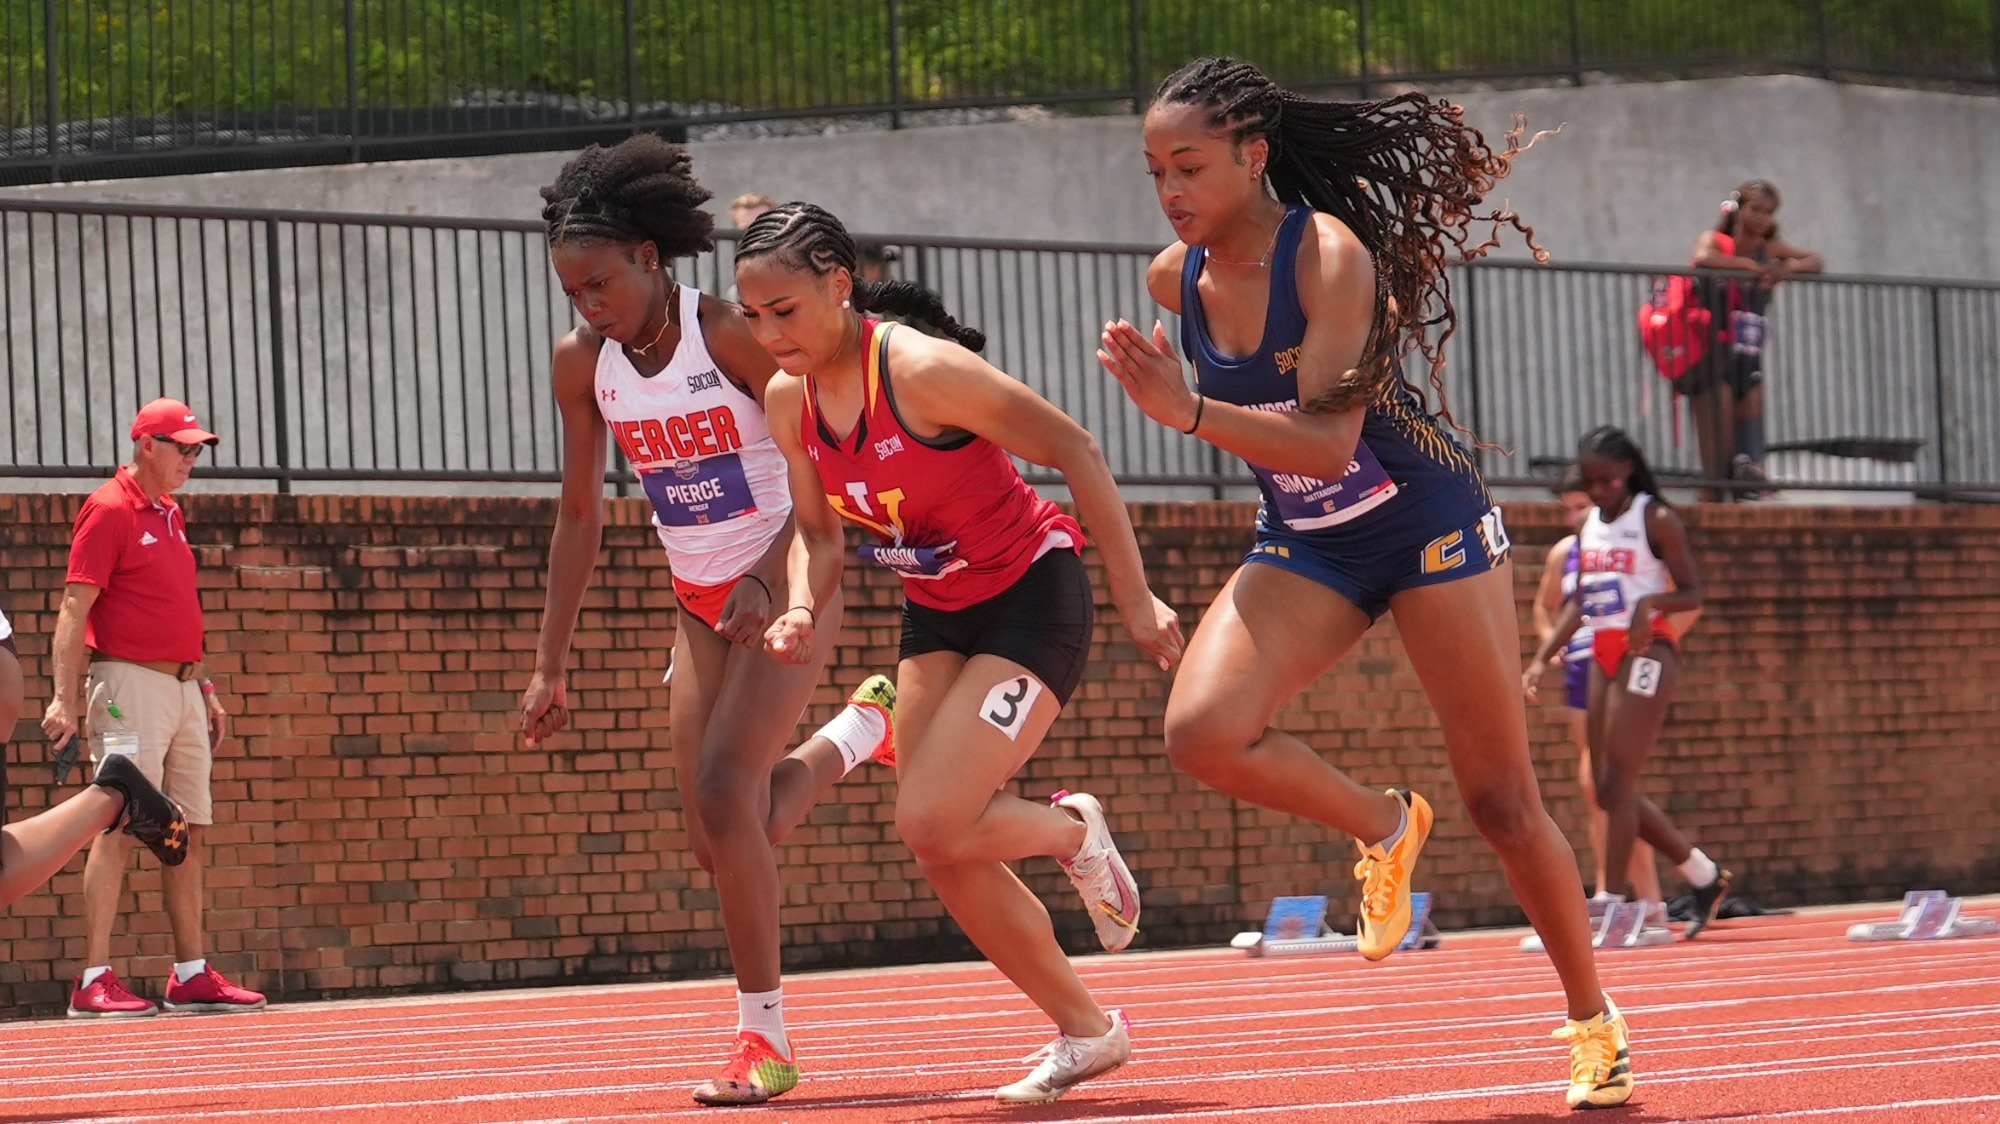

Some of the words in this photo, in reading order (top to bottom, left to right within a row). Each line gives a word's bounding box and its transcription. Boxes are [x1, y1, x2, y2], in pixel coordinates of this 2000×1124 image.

[1274, 347, 1301, 375] SOC
[1272, 455, 1361, 494] SIMMS
[665, 477, 725, 505] PIERCE
[873, 547, 922, 566] FAISON
[1421, 529, 1466, 575] C
[1639, 662, 1656, 690] 8
[989, 677, 1029, 728] 3
